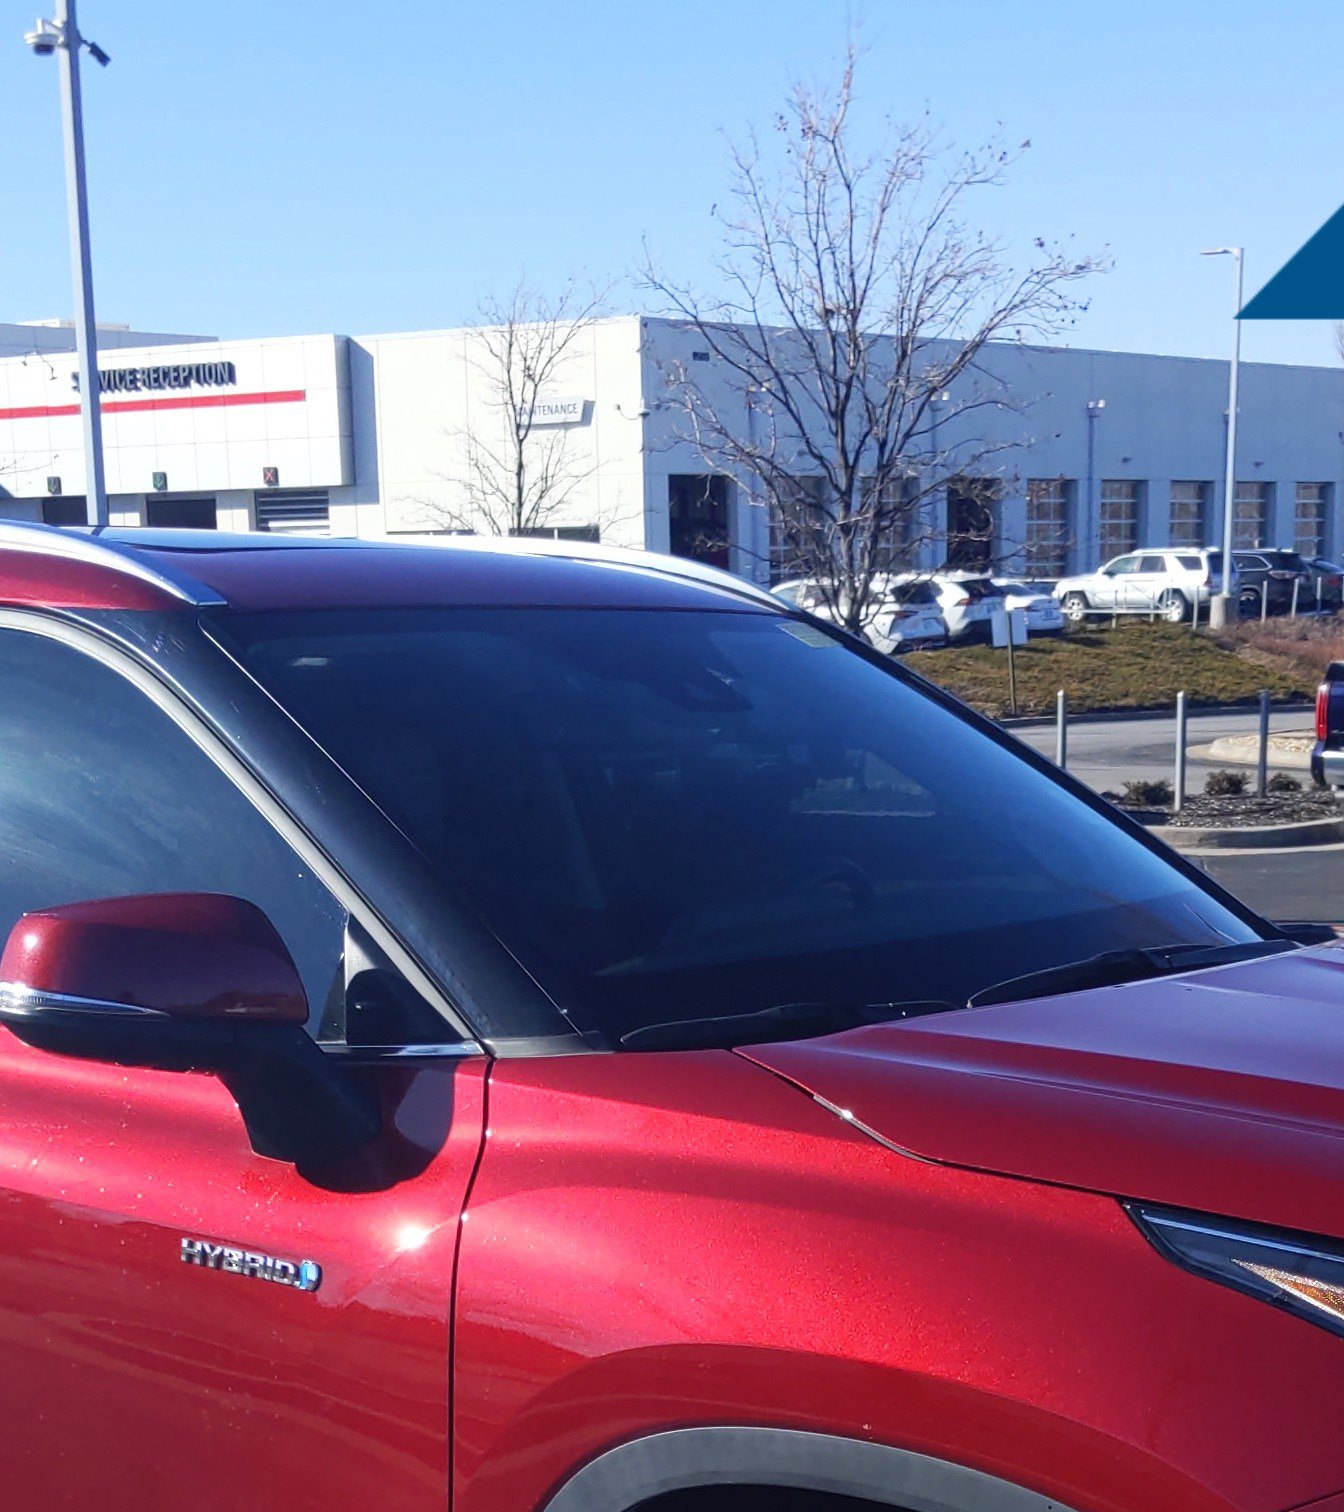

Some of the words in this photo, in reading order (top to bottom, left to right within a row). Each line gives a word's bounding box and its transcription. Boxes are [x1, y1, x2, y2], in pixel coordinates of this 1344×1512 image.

[71, 367, 140, 393] SVICE
[139, 361, 235, 391] RECEPTION
[181, 1237, 296, 1287] HYBRID
